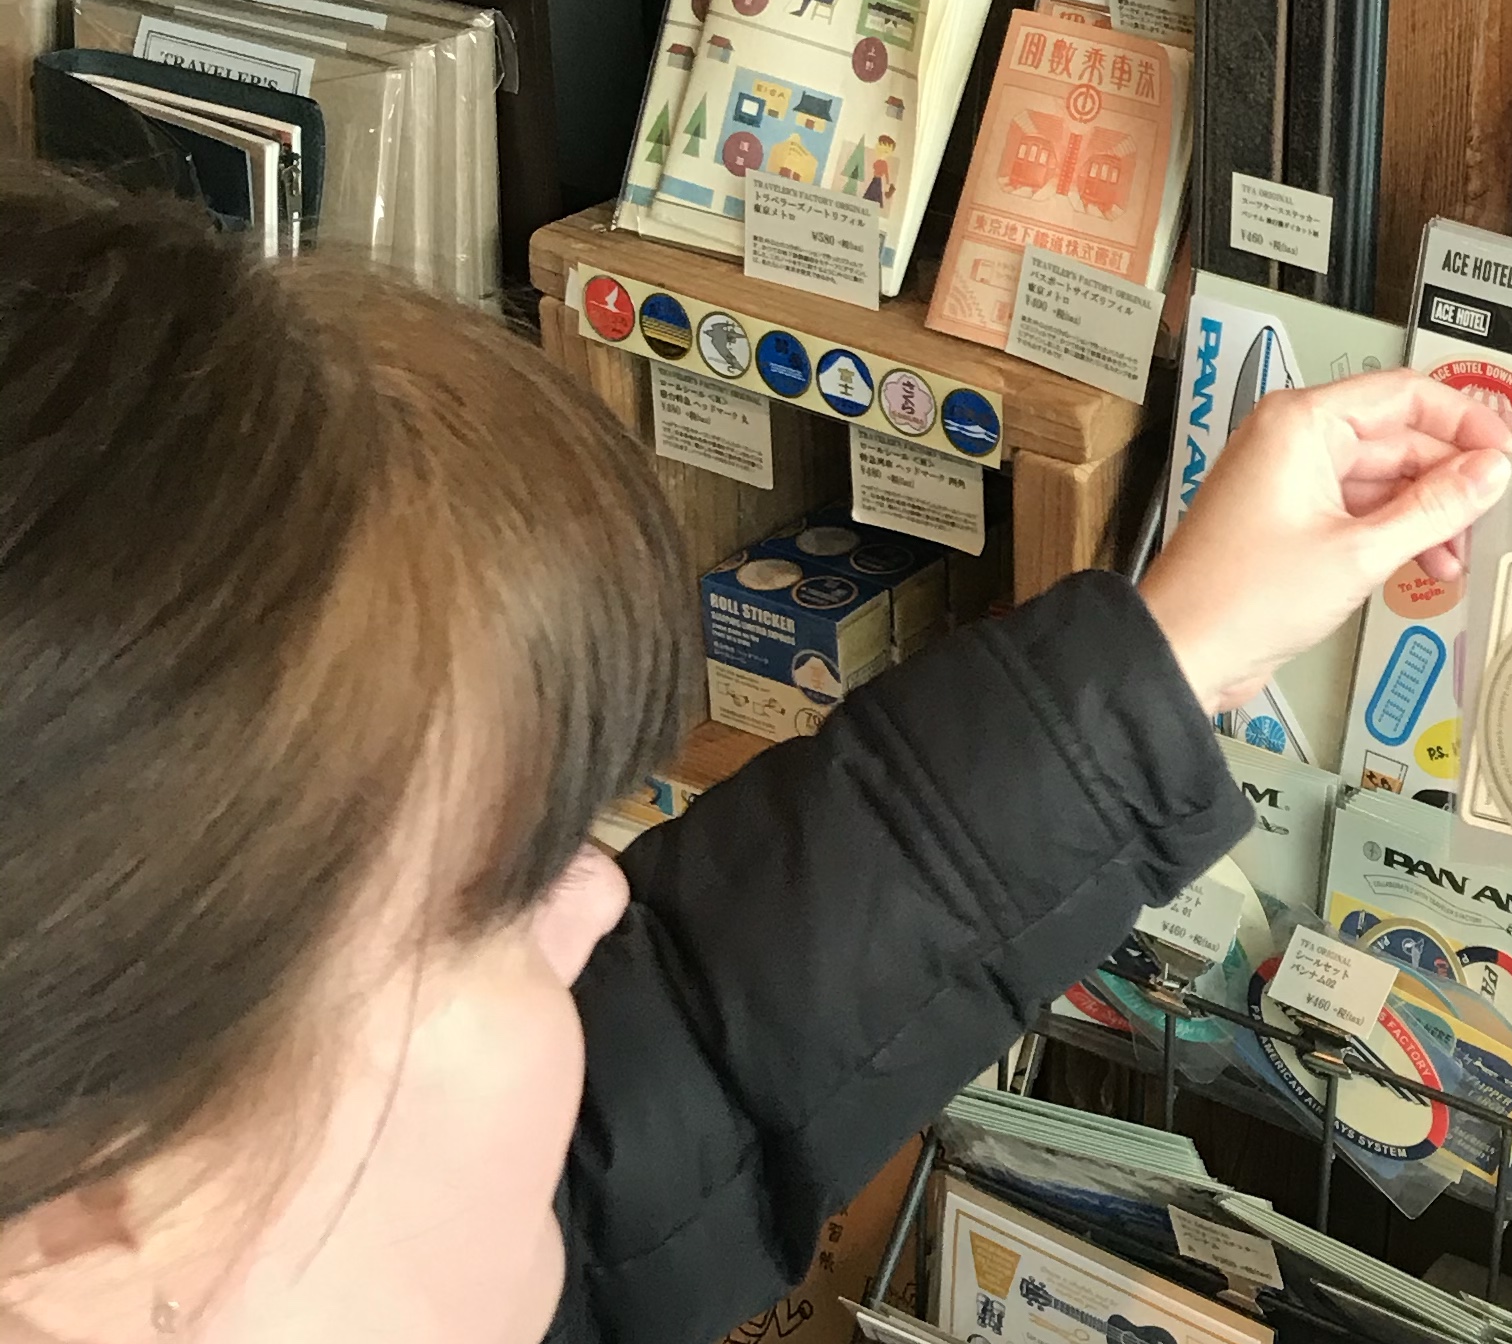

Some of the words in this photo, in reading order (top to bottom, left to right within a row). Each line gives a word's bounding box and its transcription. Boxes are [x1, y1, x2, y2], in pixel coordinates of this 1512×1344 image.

[1442, 249, 1470, 276] ACE
[1434, 301, 1456, 322] ACE
[1456, 307, 1487, 331] HOTEL
[838, 366, 856, 397] 富士
[1432, 367, 1451, 382] ACE
[1452, 362, 1484, 377] HOTEL
[901, 379, 914, 416] さくら
[709, 592, 740, 617] ROLL
[742, 603, 796, 634] STICKER
[1383, 846, 1471, 895] PAN
[1161, 920, 1187, 938] ¥460
[1295, 949, 1350, 980] シールセット
[1305, 993, 1332, 1012] ¥460
[1385, 1014, 1432, 1078] FACTORY
